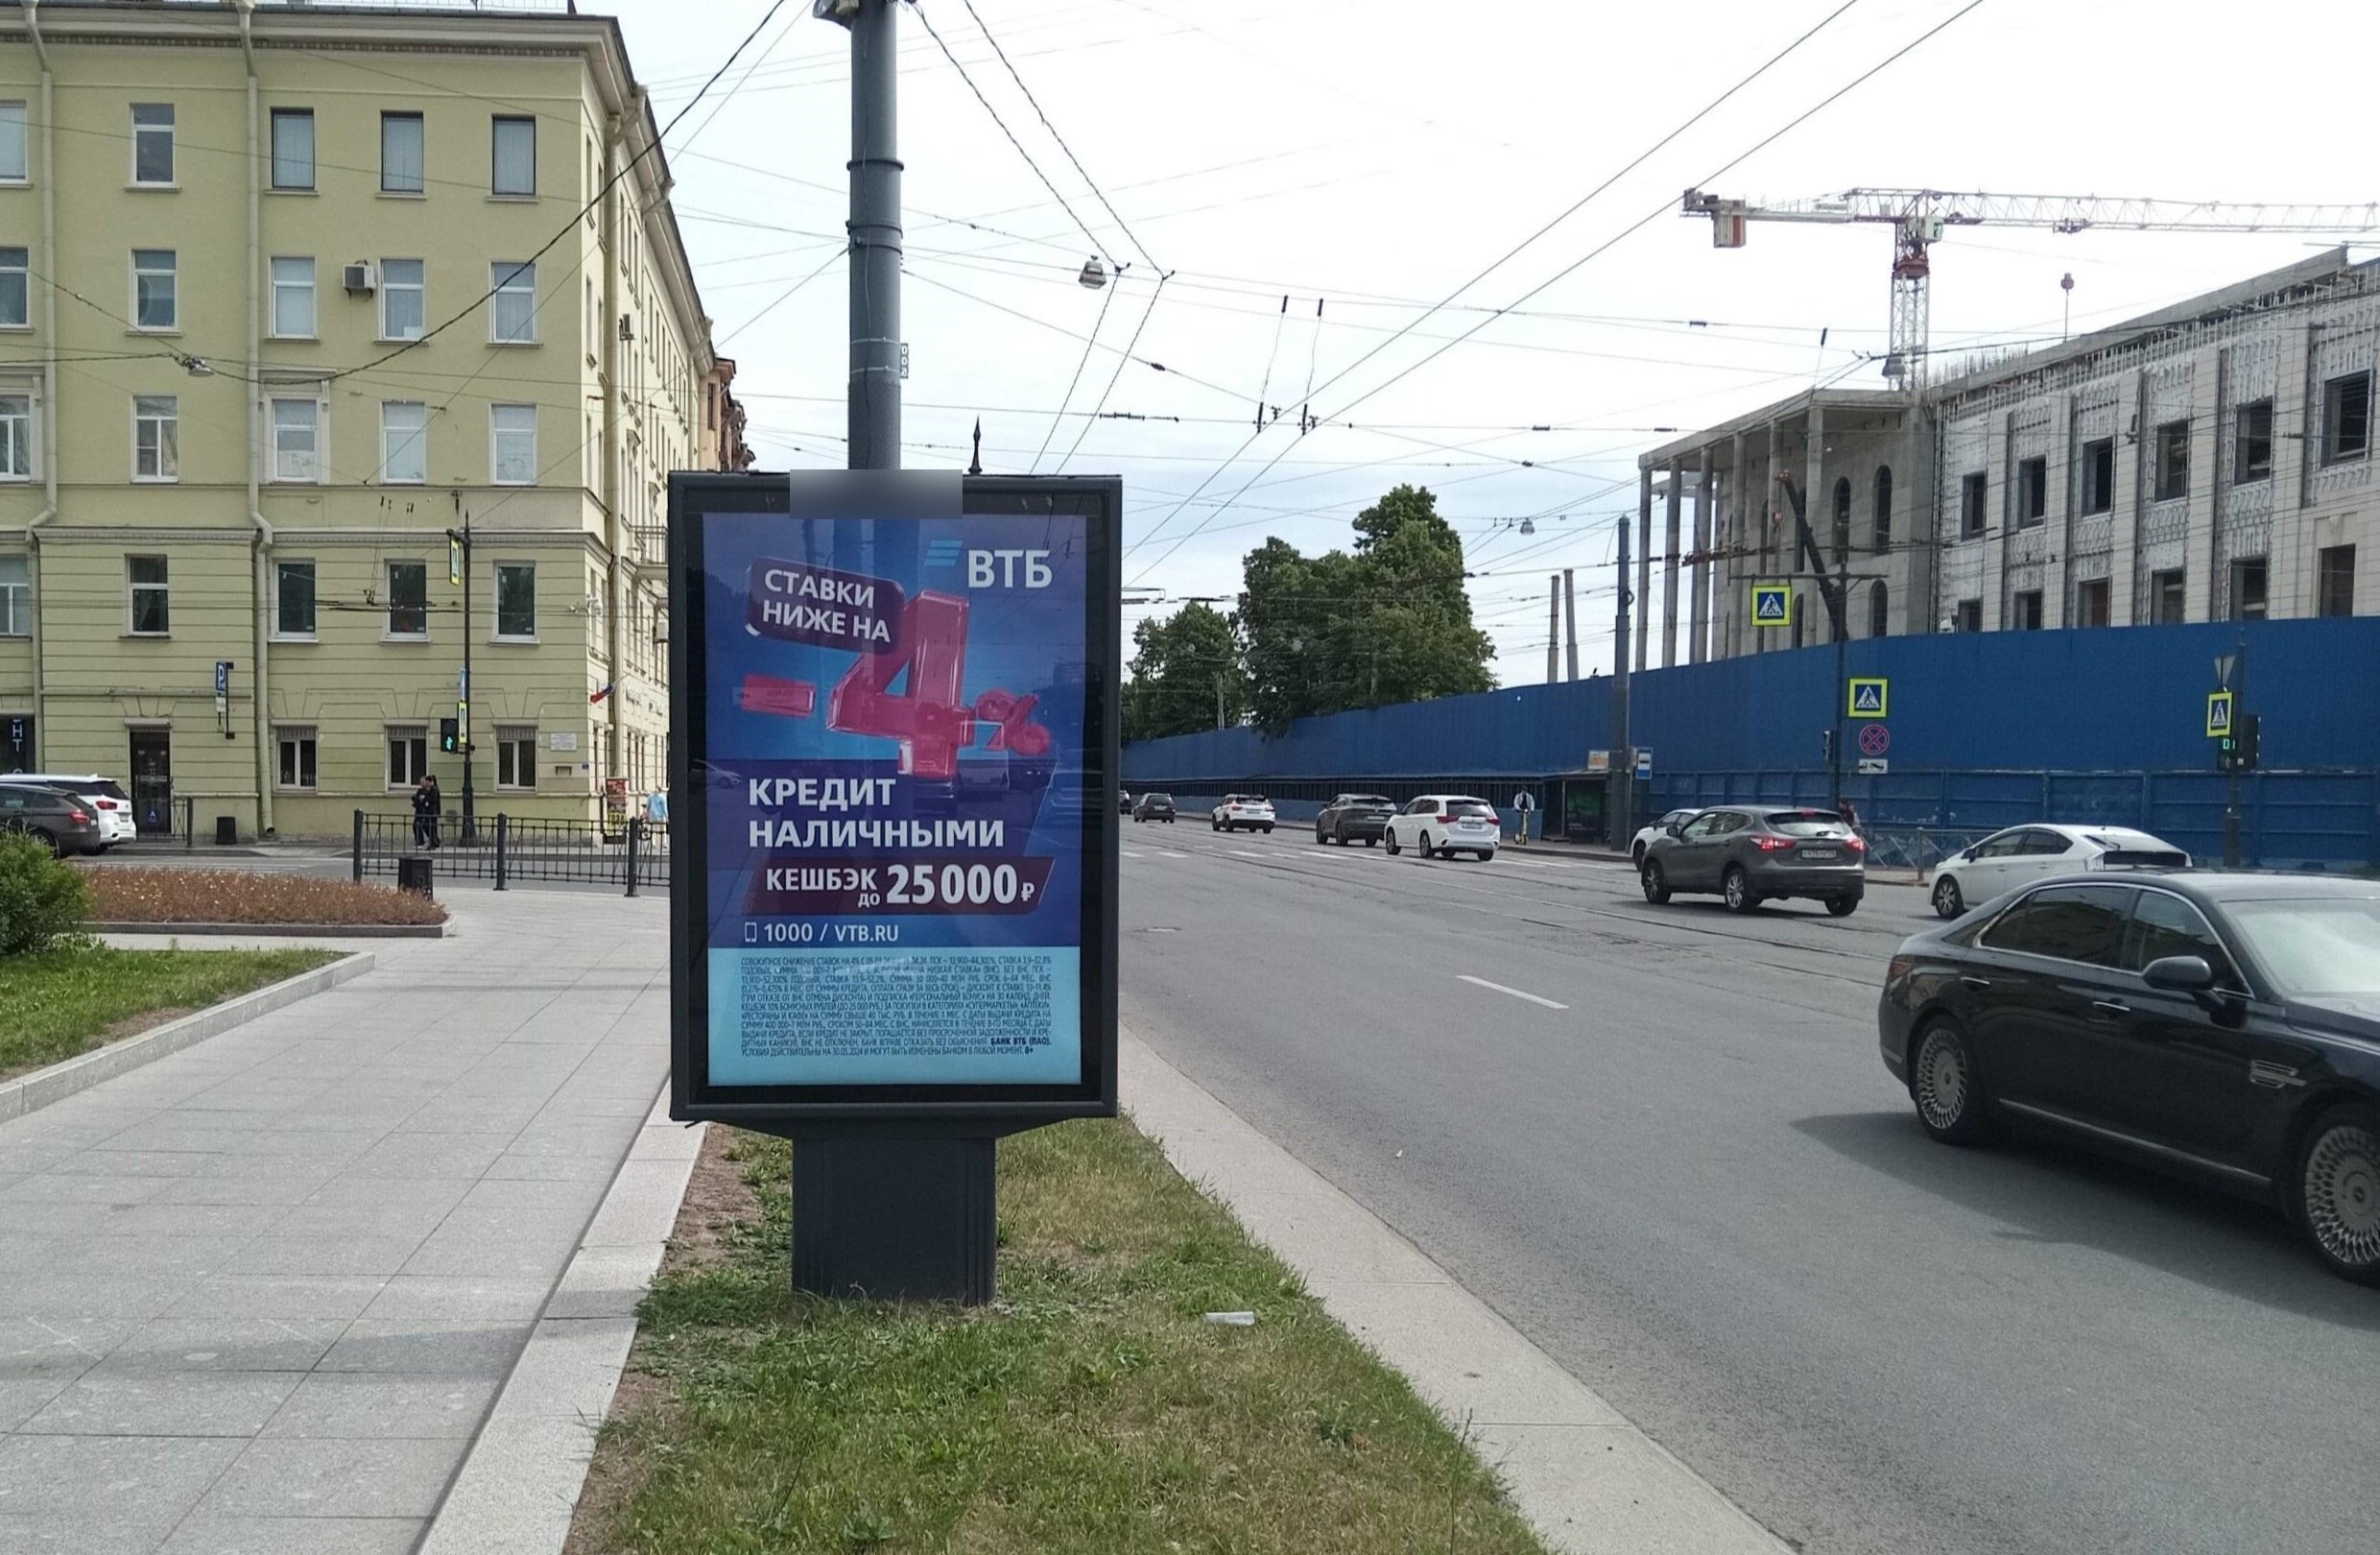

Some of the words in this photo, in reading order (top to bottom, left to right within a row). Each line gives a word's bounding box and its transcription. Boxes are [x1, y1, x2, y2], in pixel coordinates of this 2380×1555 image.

[968, 549, 1053, 588] ВТБ
[764, 569, 874, 609] СТАВКИ
[762, 600, 846, 634] НИЖЕ
[853, 616, 891, 643] НА
[749, 778, 896, 811] КРЕДИТ
[749, 820, 1004, 848] НАЛИЧНЫМИ
[767, 868, 878, 891] КЕШБЭК
[764, 922, 813, 942] 1000
[834, 924, 899, 942] VTB.RU
